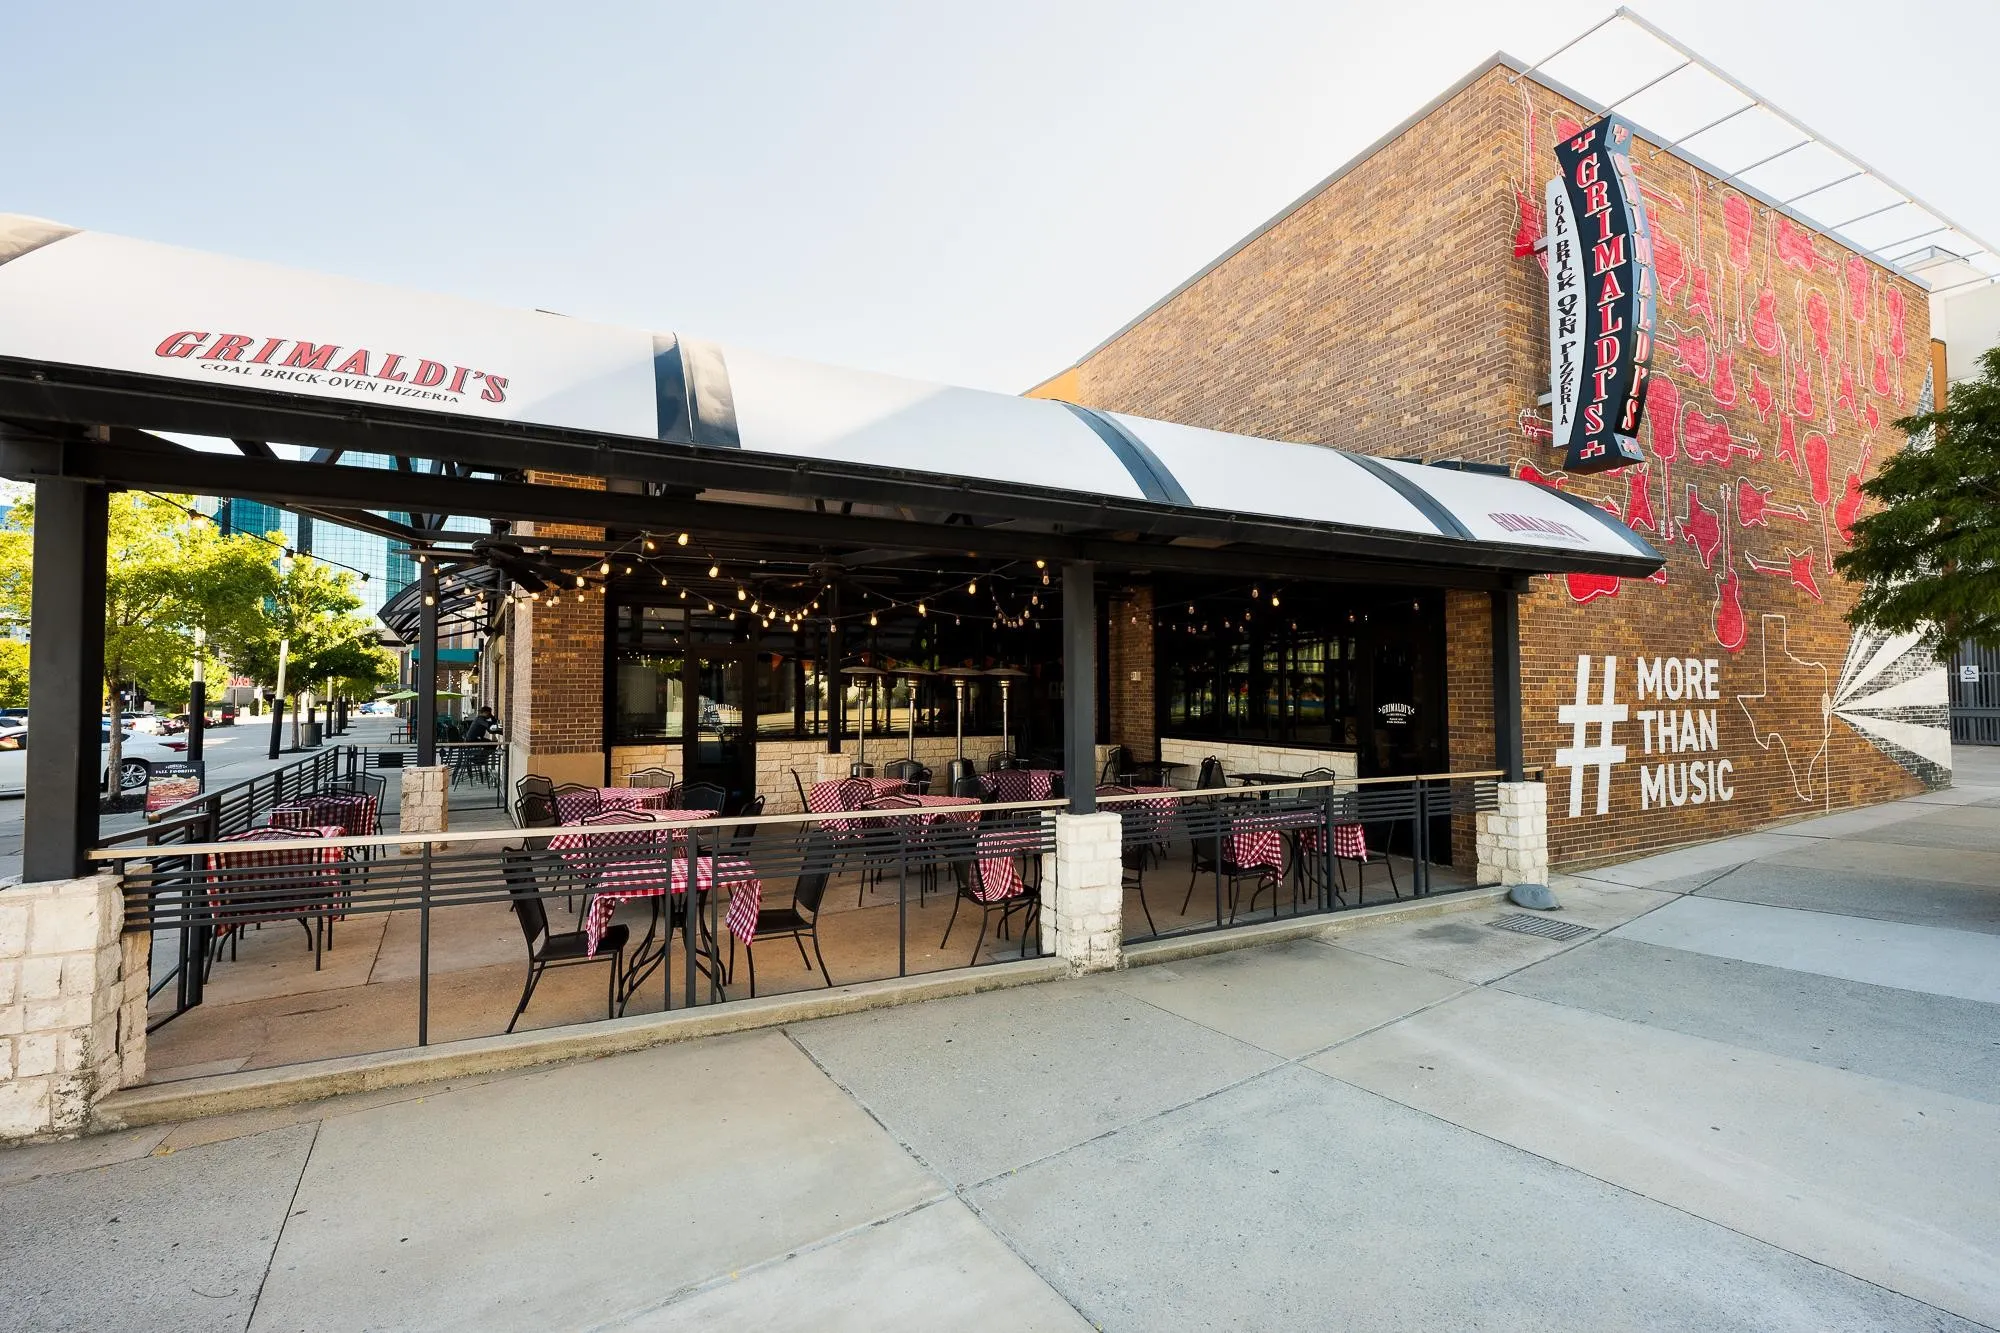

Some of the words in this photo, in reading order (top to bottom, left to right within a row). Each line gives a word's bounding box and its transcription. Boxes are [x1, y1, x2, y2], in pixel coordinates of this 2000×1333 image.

[1554, 194, 1568, 236] COAL
[1556, 239, 1576, 292] BRICK
[1557, 293, 1578, 339] OVEN
[1575, 153, 1627, 436] GRIMALDI'S
[155, 330, 510, 404] GRIMALDI'S
[200, 363, 253, 376] COAL
[260, 368, 381, 392] BRICK-OVEN
[383, 384, 460, 403] PIZZERIA
[1560, 340, 1577, 425] PIZZERIA
[1637, 656, 1720, 701] MORE
[1381, 703, 1412, 715] GRIMALDI'S
[1637, 709, 1718, 755] THAN
[1640, 758, 1734, 811] MUSIC
